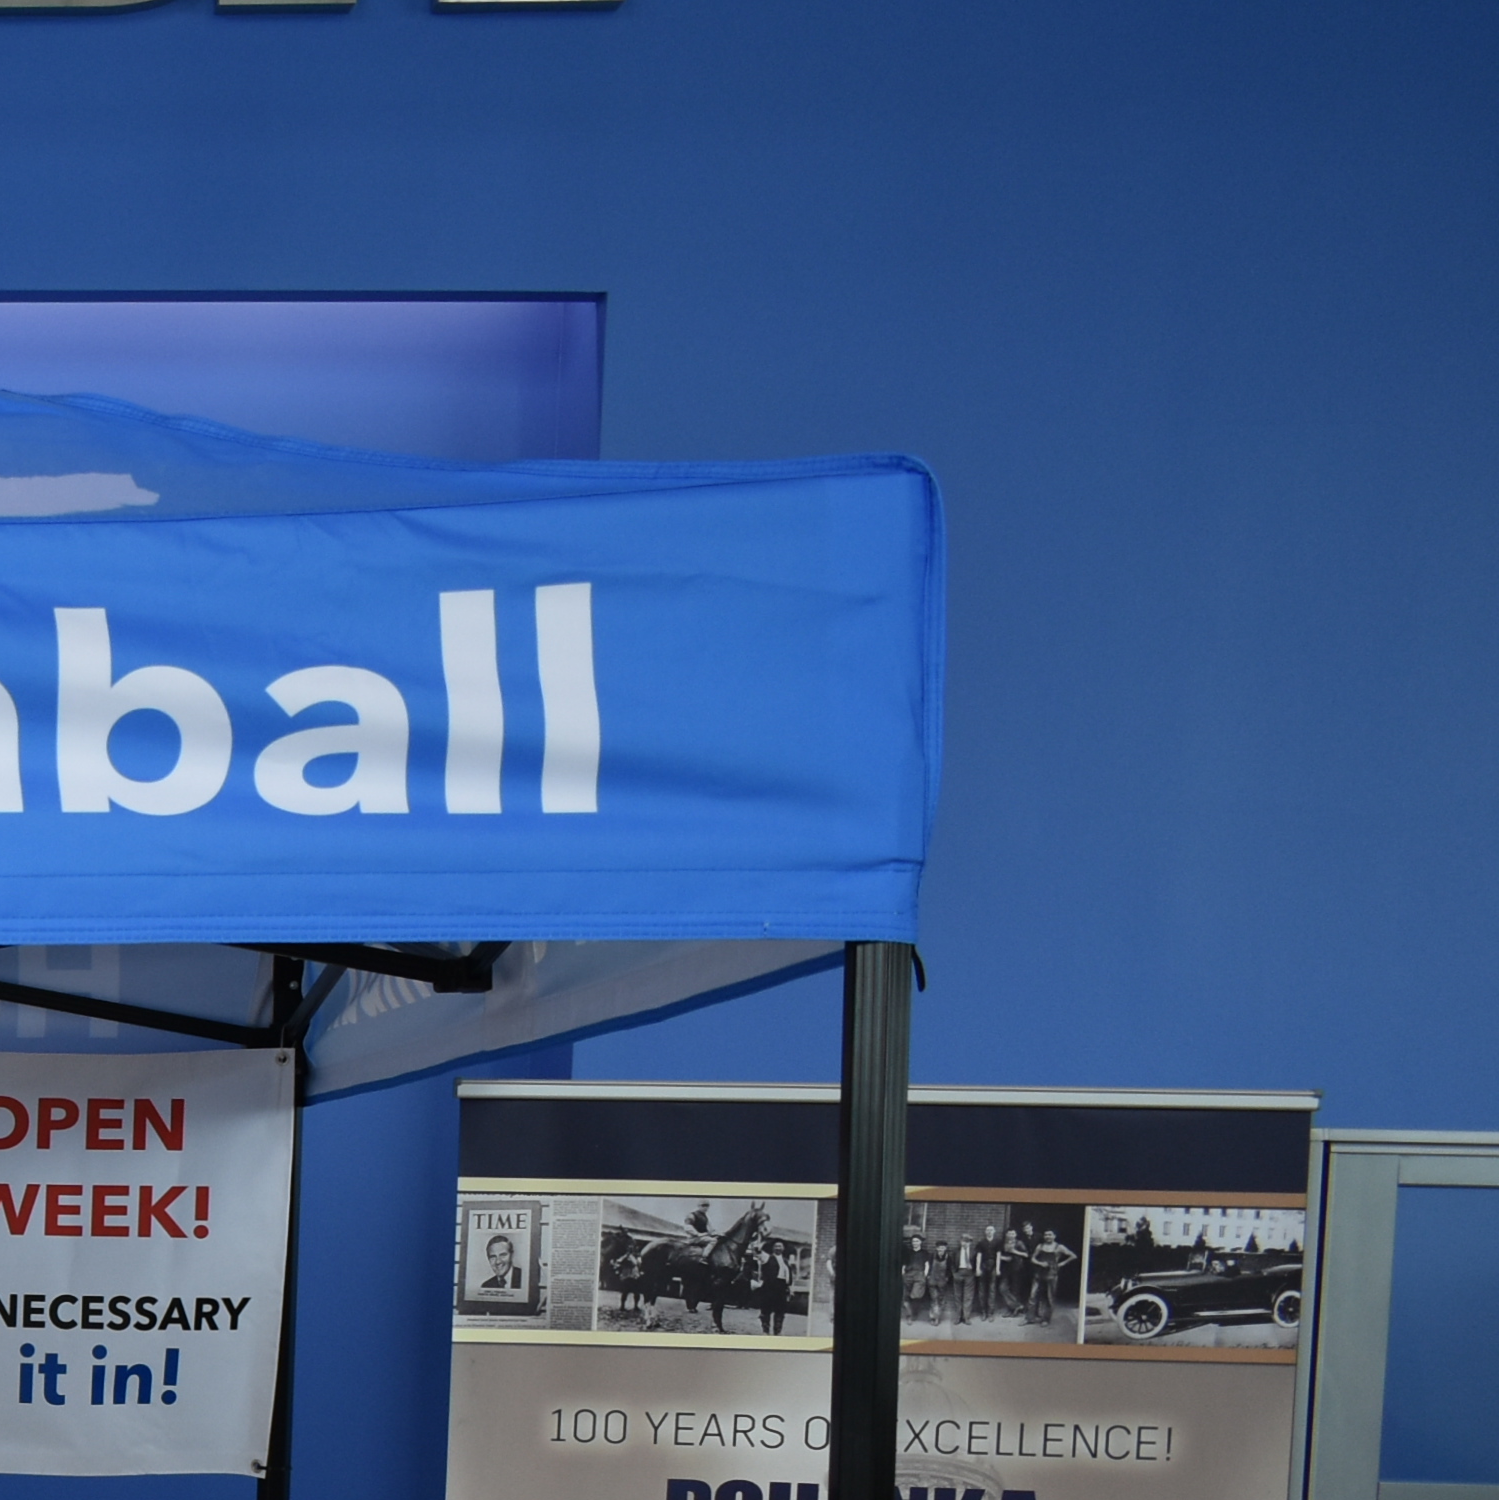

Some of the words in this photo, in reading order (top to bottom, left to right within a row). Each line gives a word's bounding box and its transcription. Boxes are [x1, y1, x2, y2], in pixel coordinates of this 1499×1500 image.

[472, 1213, 528, 1230] TIME
[17, 1342, 68, 1407] it
[90, 1343, 181, 1406] in!
[547, 1407, 629, 1446] 100
[644, 1410, 787, 1452] YEARS
[903, 1419, 1176, 1463] XCELLENCE!
